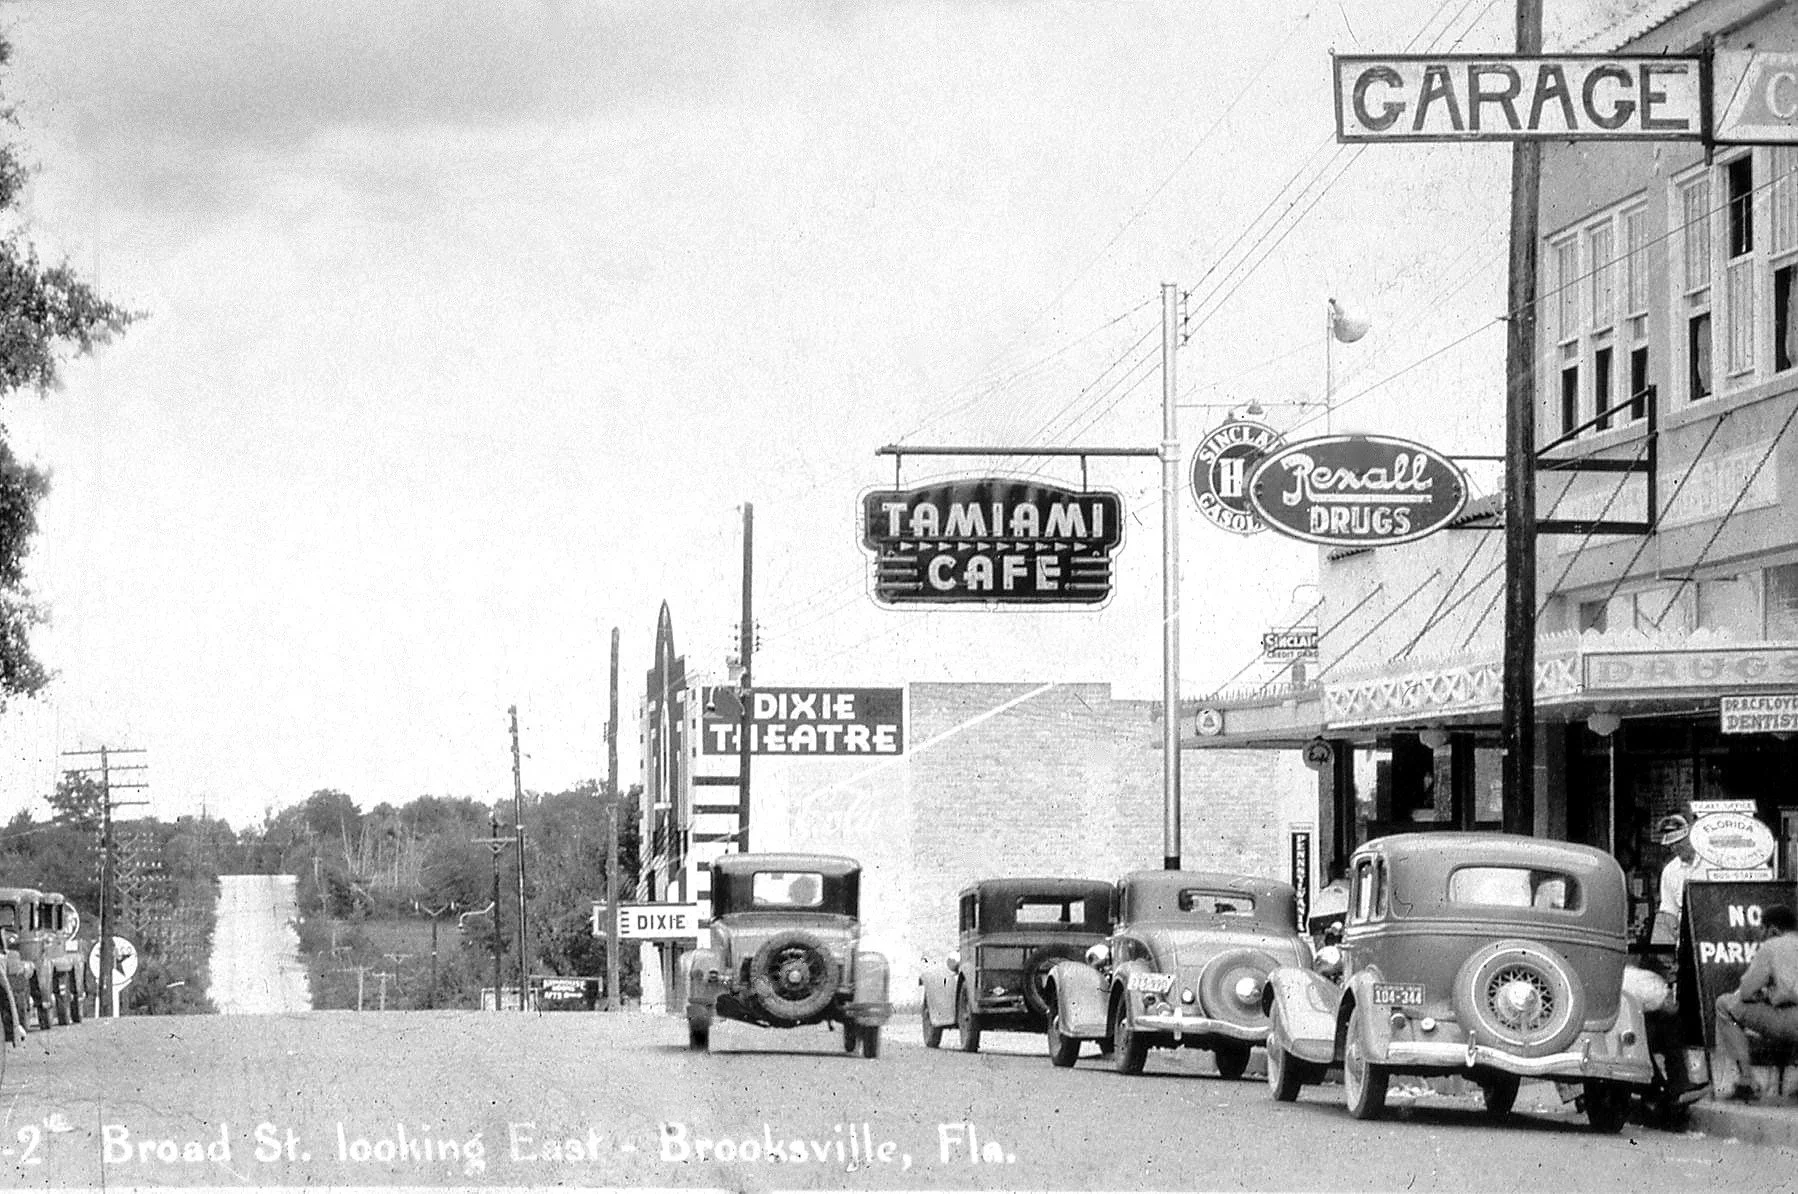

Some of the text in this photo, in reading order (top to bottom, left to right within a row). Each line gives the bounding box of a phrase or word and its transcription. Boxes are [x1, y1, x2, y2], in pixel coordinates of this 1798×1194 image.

[1353, 64, 1690, 131] GARAGE
[1199, 427, 1286, 464] SINCLAI
[1280, 452, 1433, 506] Rexall
[882, 502, 1103, 538] TAMIAMI
[1200, 492, 1265, 532] GASOL
[1310, 506, 1411, 535] DRUGS
[928, 554, 1061, 591] CAFE
[754, 693, 856, 720] DIXIE
[709, 723, 898, 753] THEATRE
[1703, 820, 1754, 833] FLORIDA
[637, 914, 686, 930] DIXIE
[1728, 904, 1762, 928] NO
[1699, 941, 1760, 964] PARK
